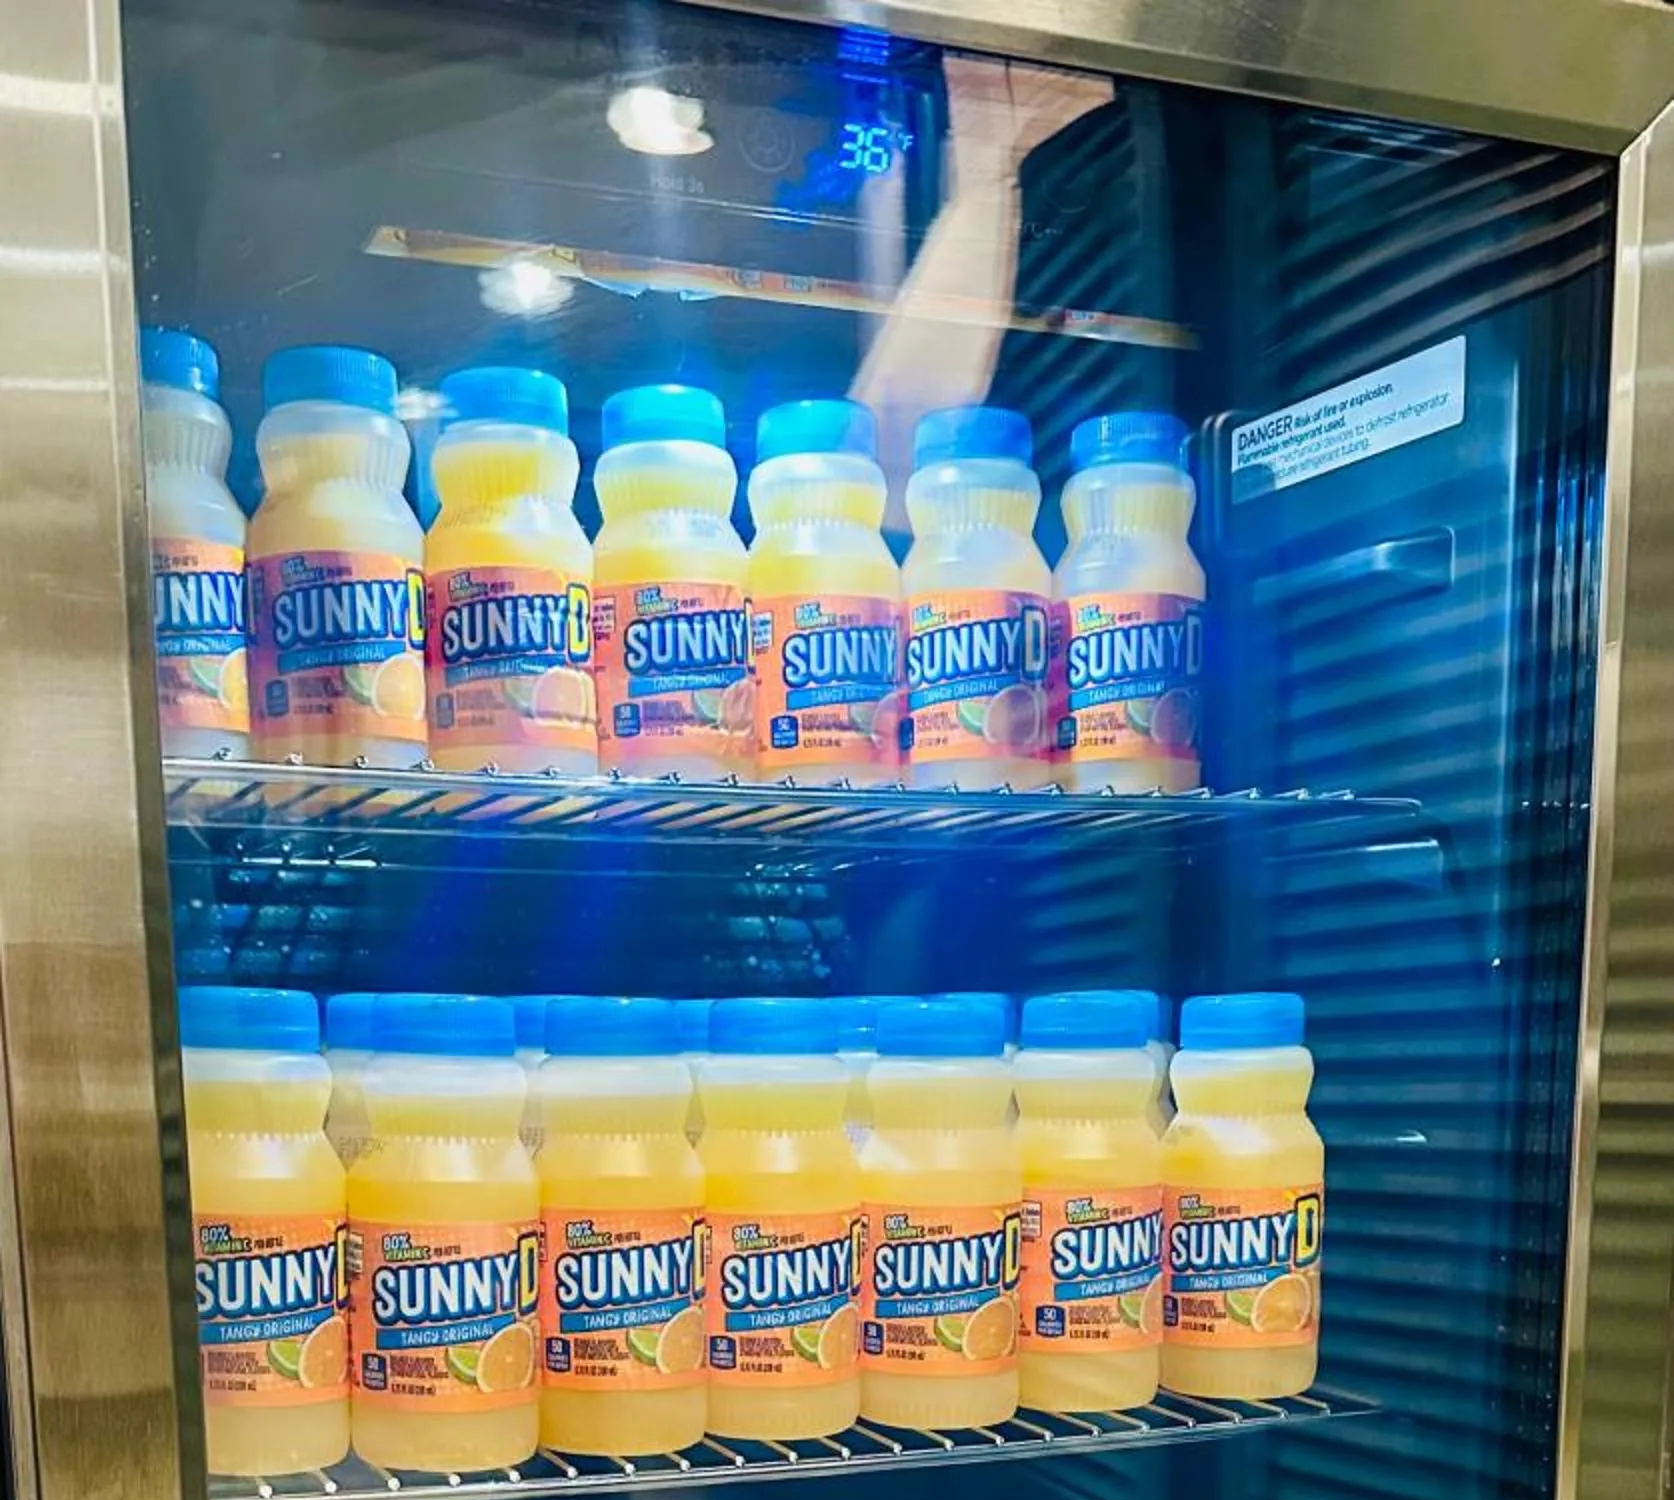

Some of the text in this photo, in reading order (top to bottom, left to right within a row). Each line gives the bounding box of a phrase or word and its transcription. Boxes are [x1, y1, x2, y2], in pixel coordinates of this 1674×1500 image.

[839, 123, 890, 173] 36
[1237, 414, 1293, 451] DANGER
[274, 569, 425, 647] SUNNYD
[442, 584, 591, 660] SUNNYD
[626, 600, 756, 672] SUNNY
[784, 618, 902, 688] SUNNY
[906, 606, 1047, 688] SUNNYD
[1068, 612, 1202, 689] SUNNYD
[201, 1226, 231, 1243] 80%
[382, 1234, 411, 1251] 80%
[732, 1225, 759, 1242] 80%
[1053, 1211, 1163, 1276] SUNNY
[1171, 1196, 1320, 1270] SUNNYD
[875, 1216, 1021, 1291] SUNNYD
[374, 1235, 539, 1321] SUNNYD
[1080, 1281, 1115, 1297] TANGY
[1188, 1271, 1270, 1290] TANGY ORIGINAL
[584, 1305, 674, 1328] TANGY ORIGINAL
[750, 1303, 832, 1327] TANGY ORIGINAL
[896, 1296, 981, 1316] TANGY ORIGINAL
[1043, 1307, 1057, 1320] 50
[219, 1315, 316, 1342] TANGY ORIGINAL
[400, 1321, 496, 1346] TANGY ORIGINAL
